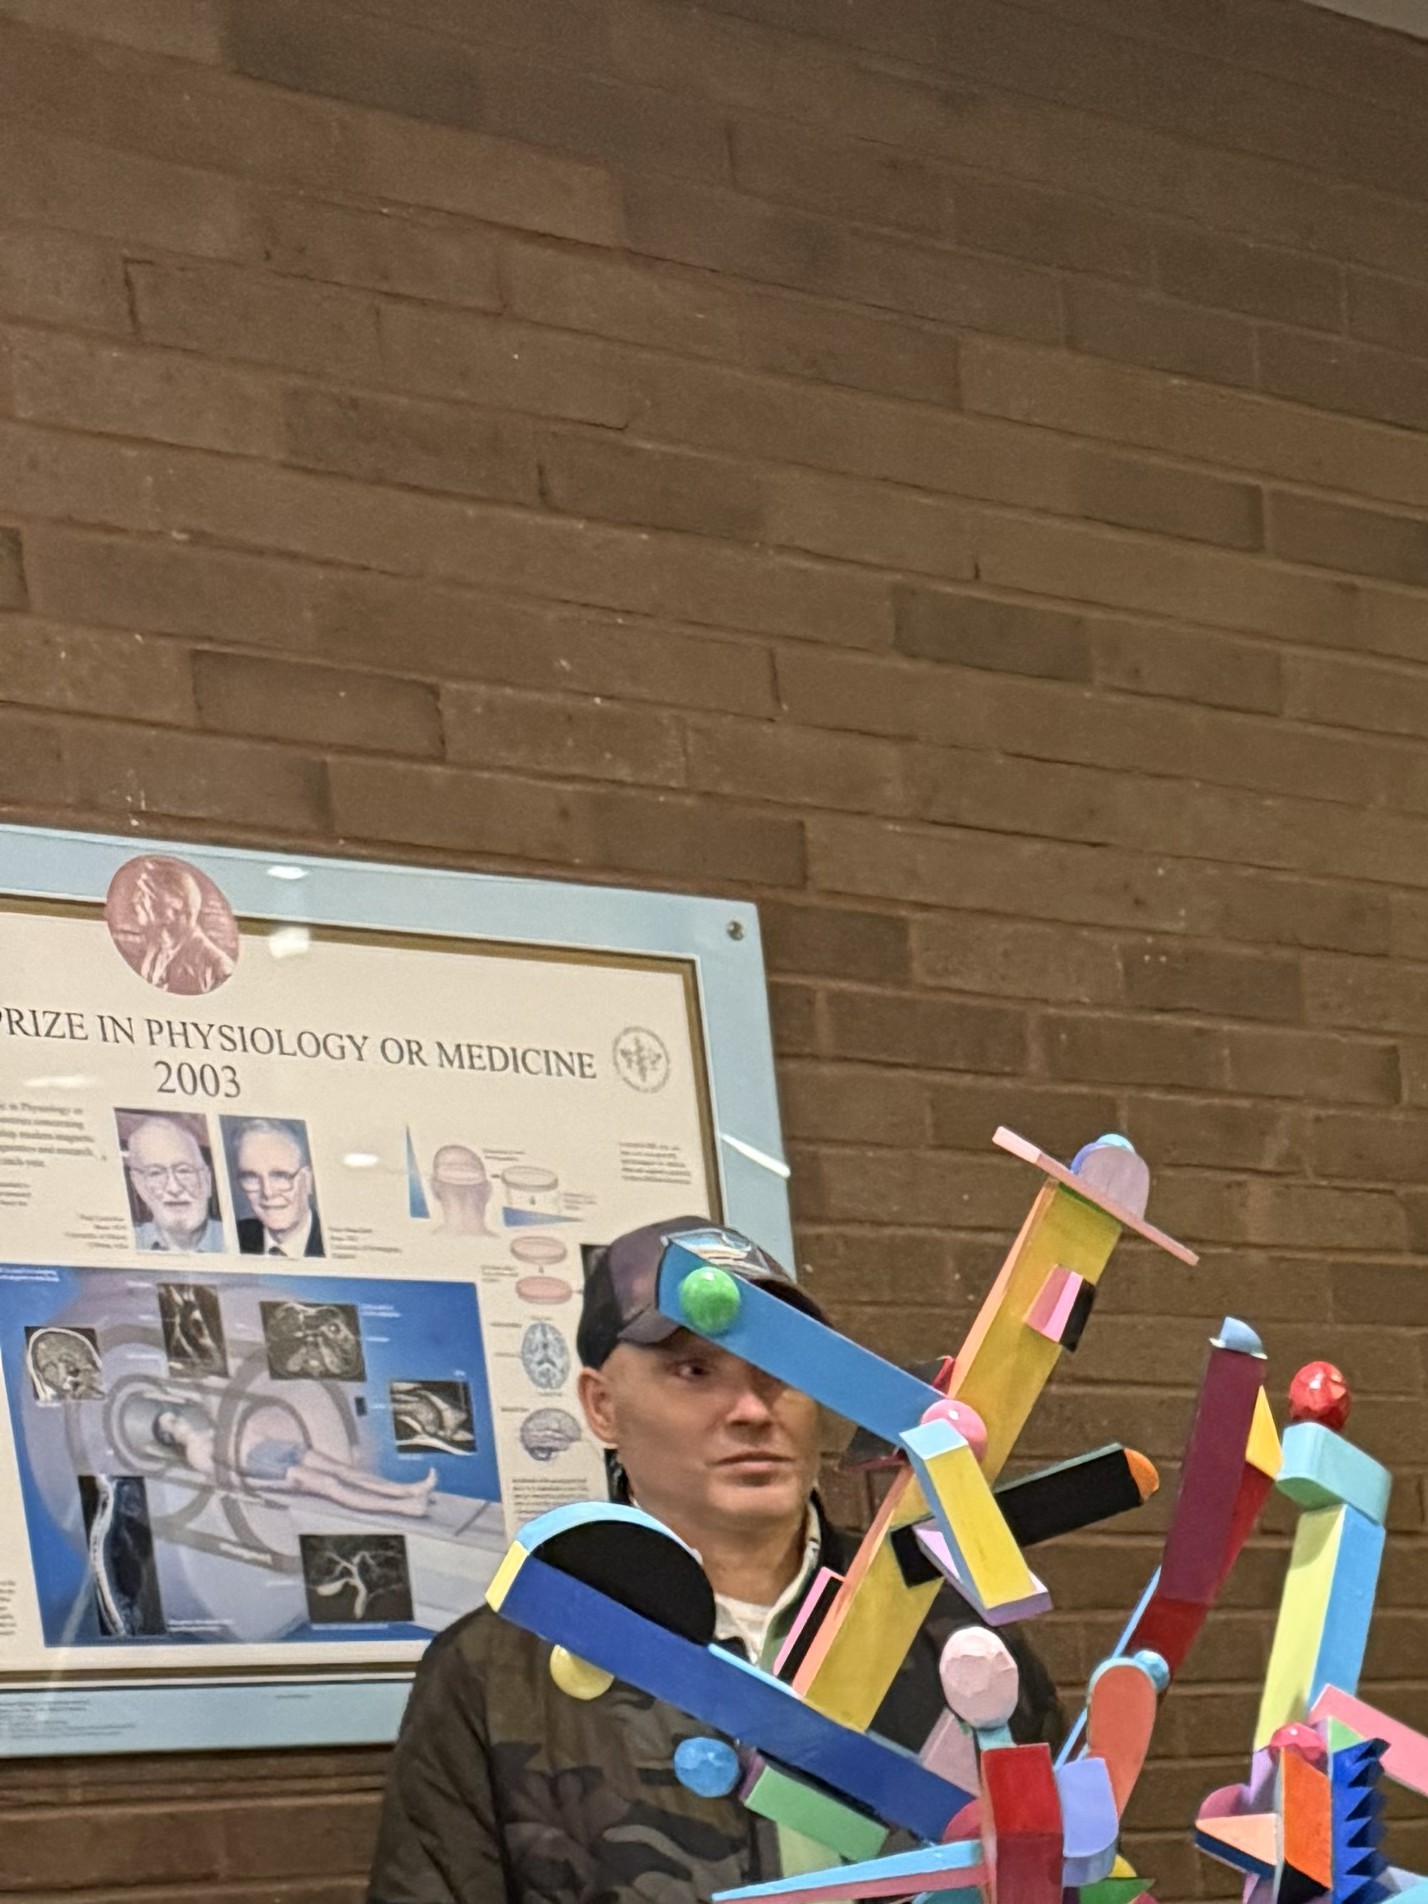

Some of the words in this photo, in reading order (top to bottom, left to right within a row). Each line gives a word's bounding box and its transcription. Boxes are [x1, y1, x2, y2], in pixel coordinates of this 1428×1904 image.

[0, 1006, 88, 1041] RIZE
[97, 1014, 136, 1045] IN
[143, 1018, 368, 1062] PHYSIOLOGY
[380, 1037, 428, 1067] OR
[435, 1041, 597, 1080] MEDICINE
[154, 1060, 241, 1098] 2003
